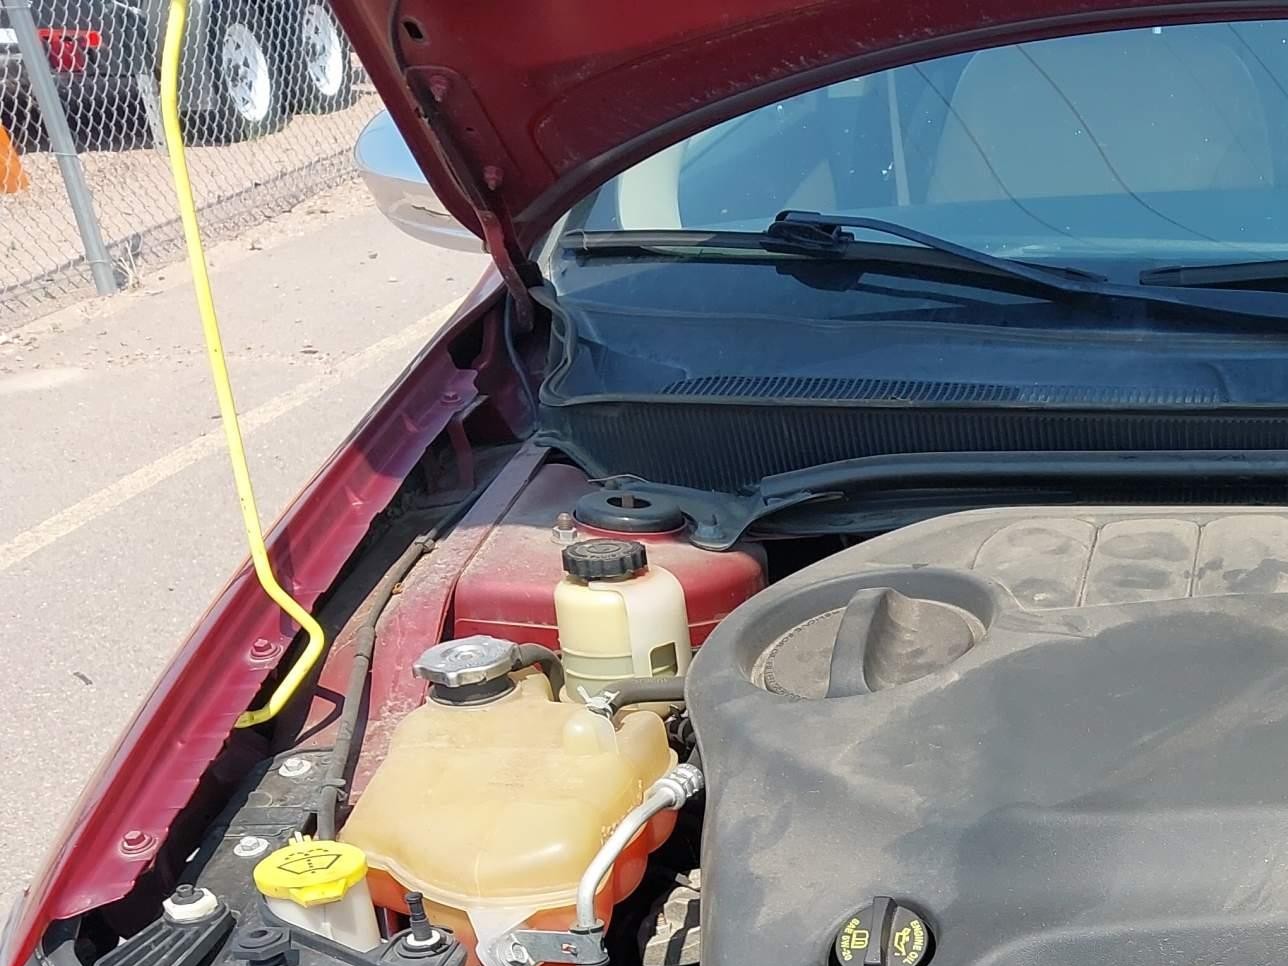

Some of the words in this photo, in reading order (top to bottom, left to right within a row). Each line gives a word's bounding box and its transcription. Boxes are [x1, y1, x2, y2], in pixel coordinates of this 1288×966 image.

[844, 918, 860, 934] SAE
[910, 920, 924, 951] ENGINE
[840, 935, 853, 961] 0W-20
[903, 951, 918, 964] OIL
